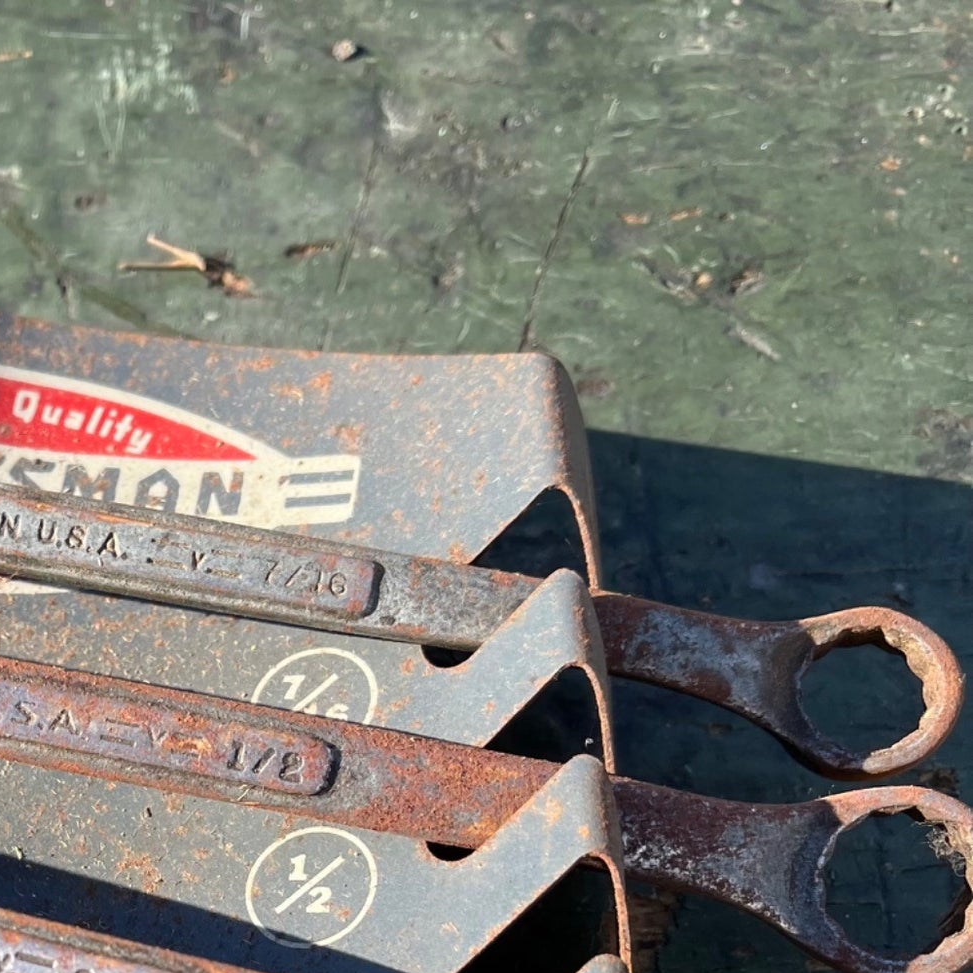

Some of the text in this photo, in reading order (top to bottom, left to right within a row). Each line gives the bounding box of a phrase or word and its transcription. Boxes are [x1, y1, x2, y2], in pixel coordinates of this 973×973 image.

[13, 389, 154, 455] Quality
[263, 560, 349, 598] 7/16
[226, 740, 306, 785] 1/2
[274, 853, 345, 914] 1/2
